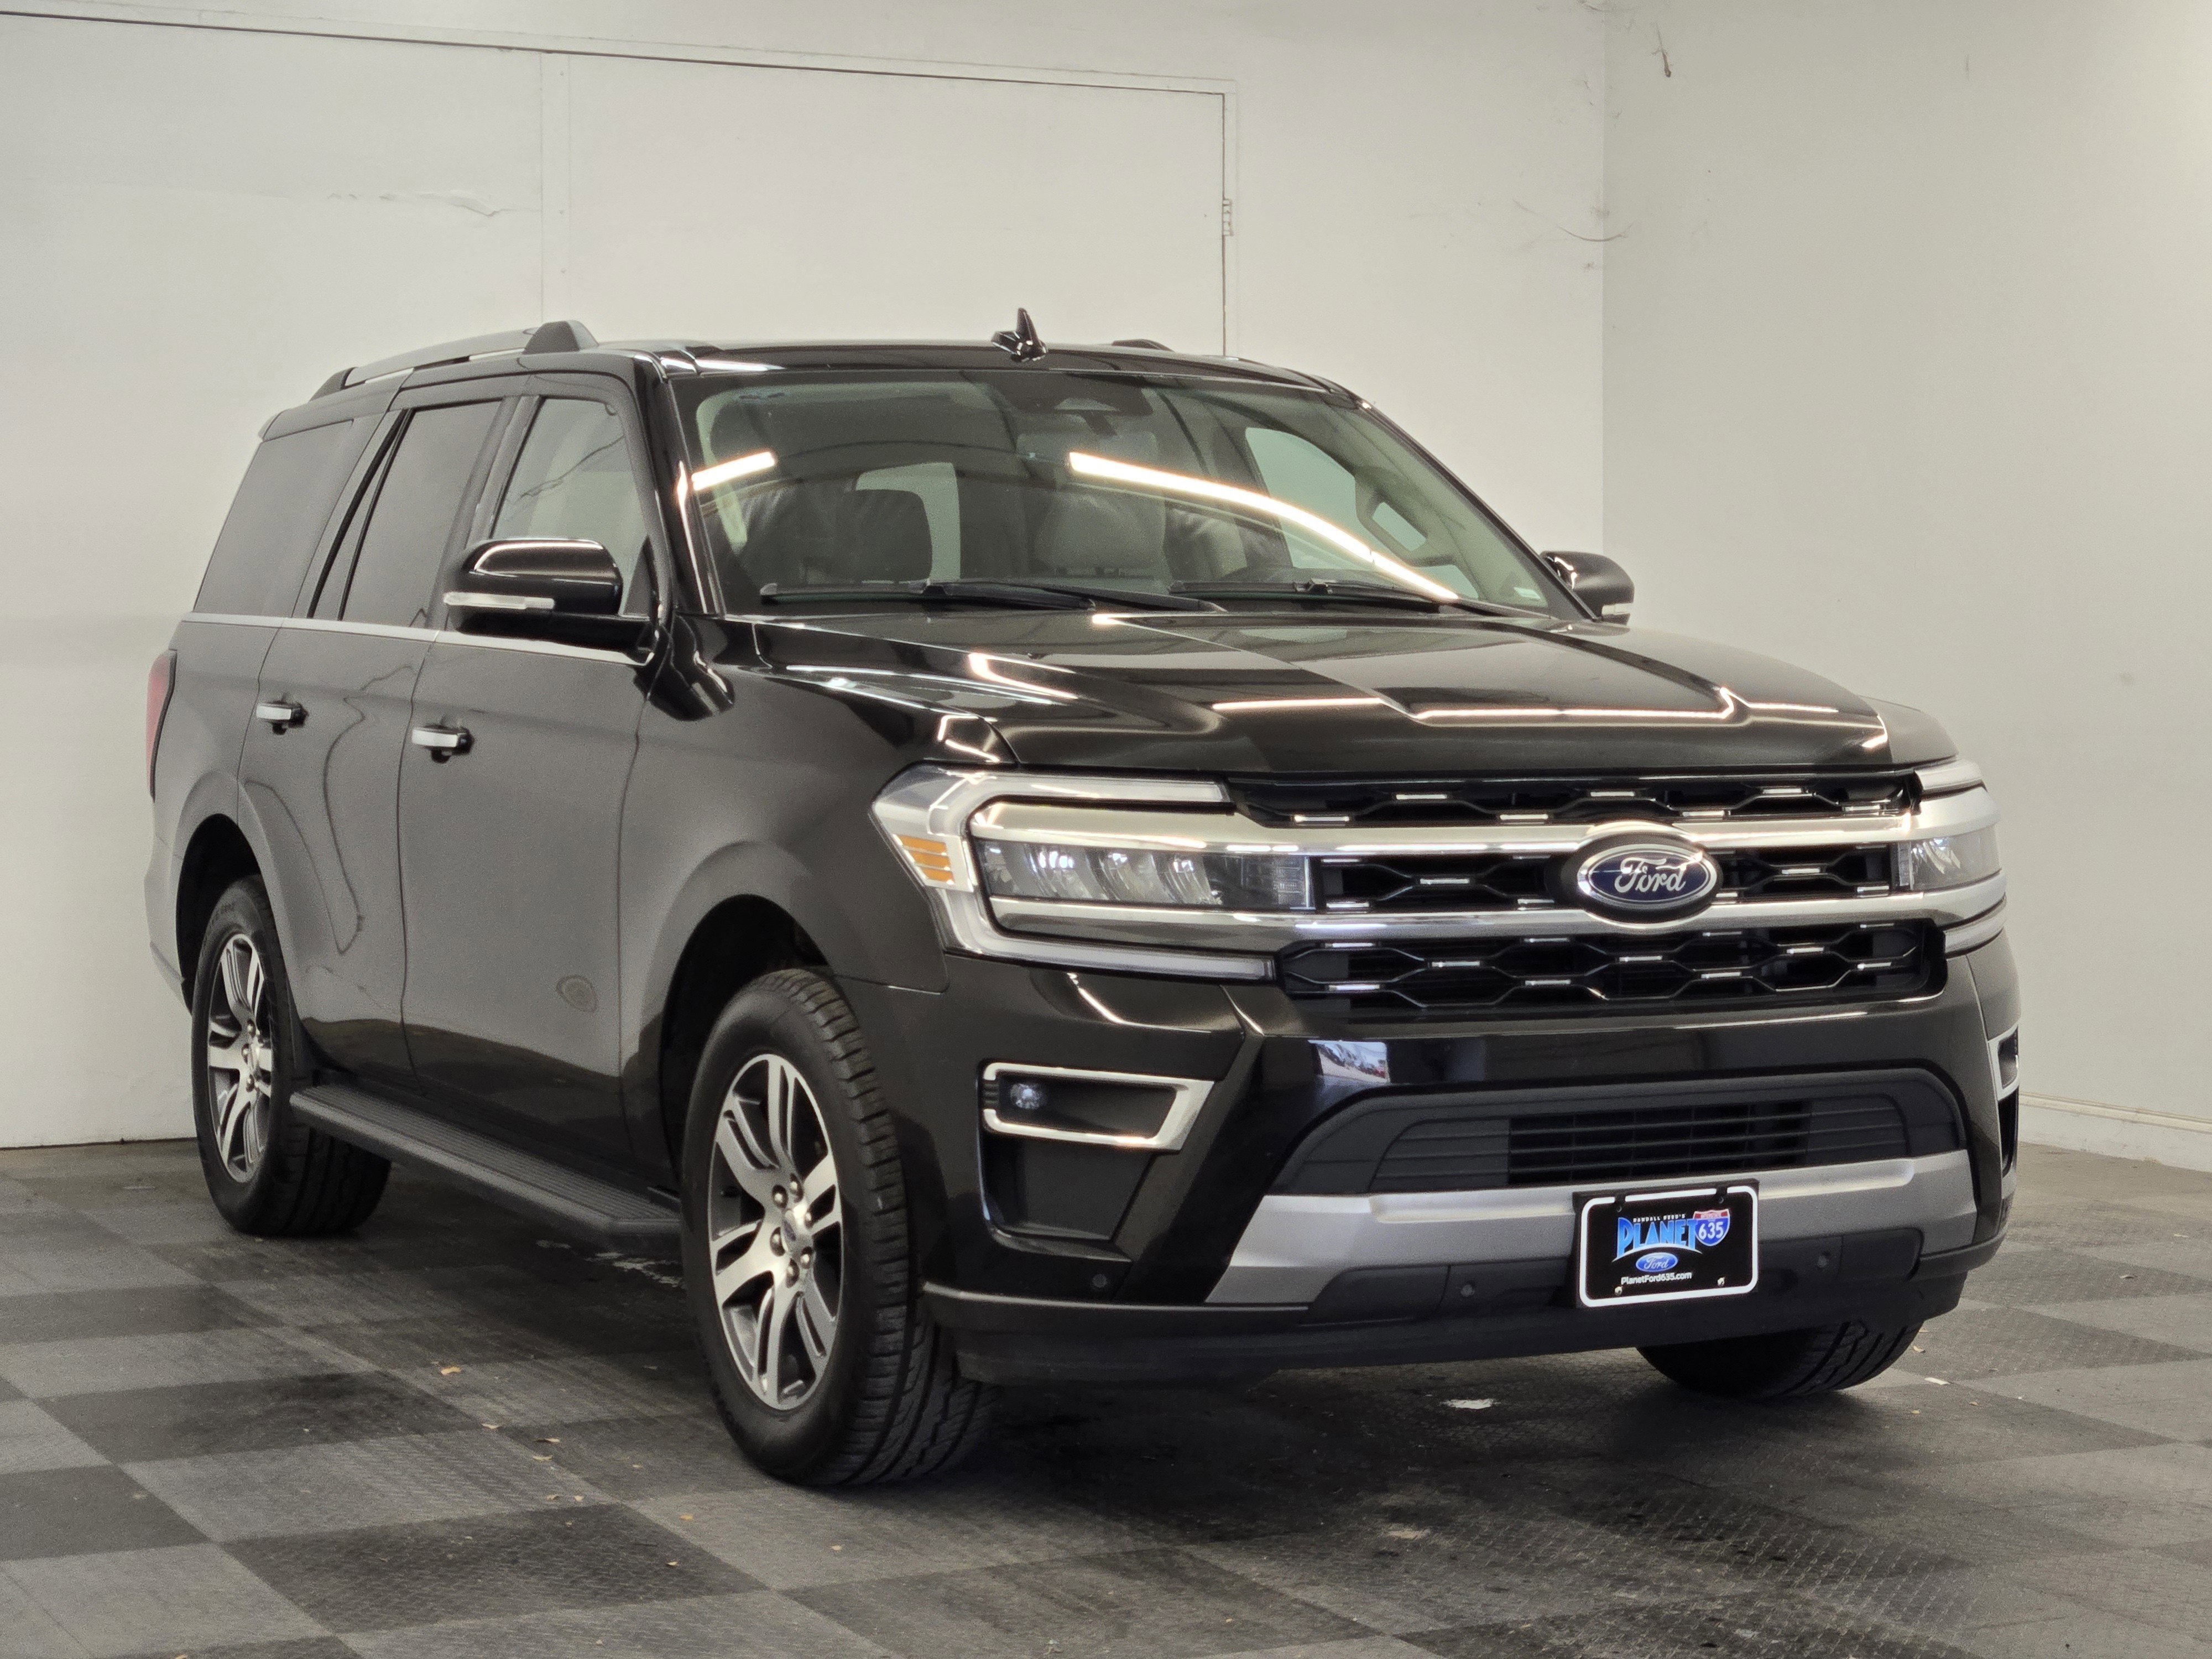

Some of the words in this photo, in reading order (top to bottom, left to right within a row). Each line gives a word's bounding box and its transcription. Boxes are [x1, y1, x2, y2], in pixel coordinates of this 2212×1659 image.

[1614, 857, 1686, 893] Ford
[1617, 1217, 1698, 1259] PLANET
[1698, 1221, 1724, 1240] 635
[1644, 1256, 1669, 1269] Ford
[1621, 1272, 1692, 1285] PlanetFord635.com
